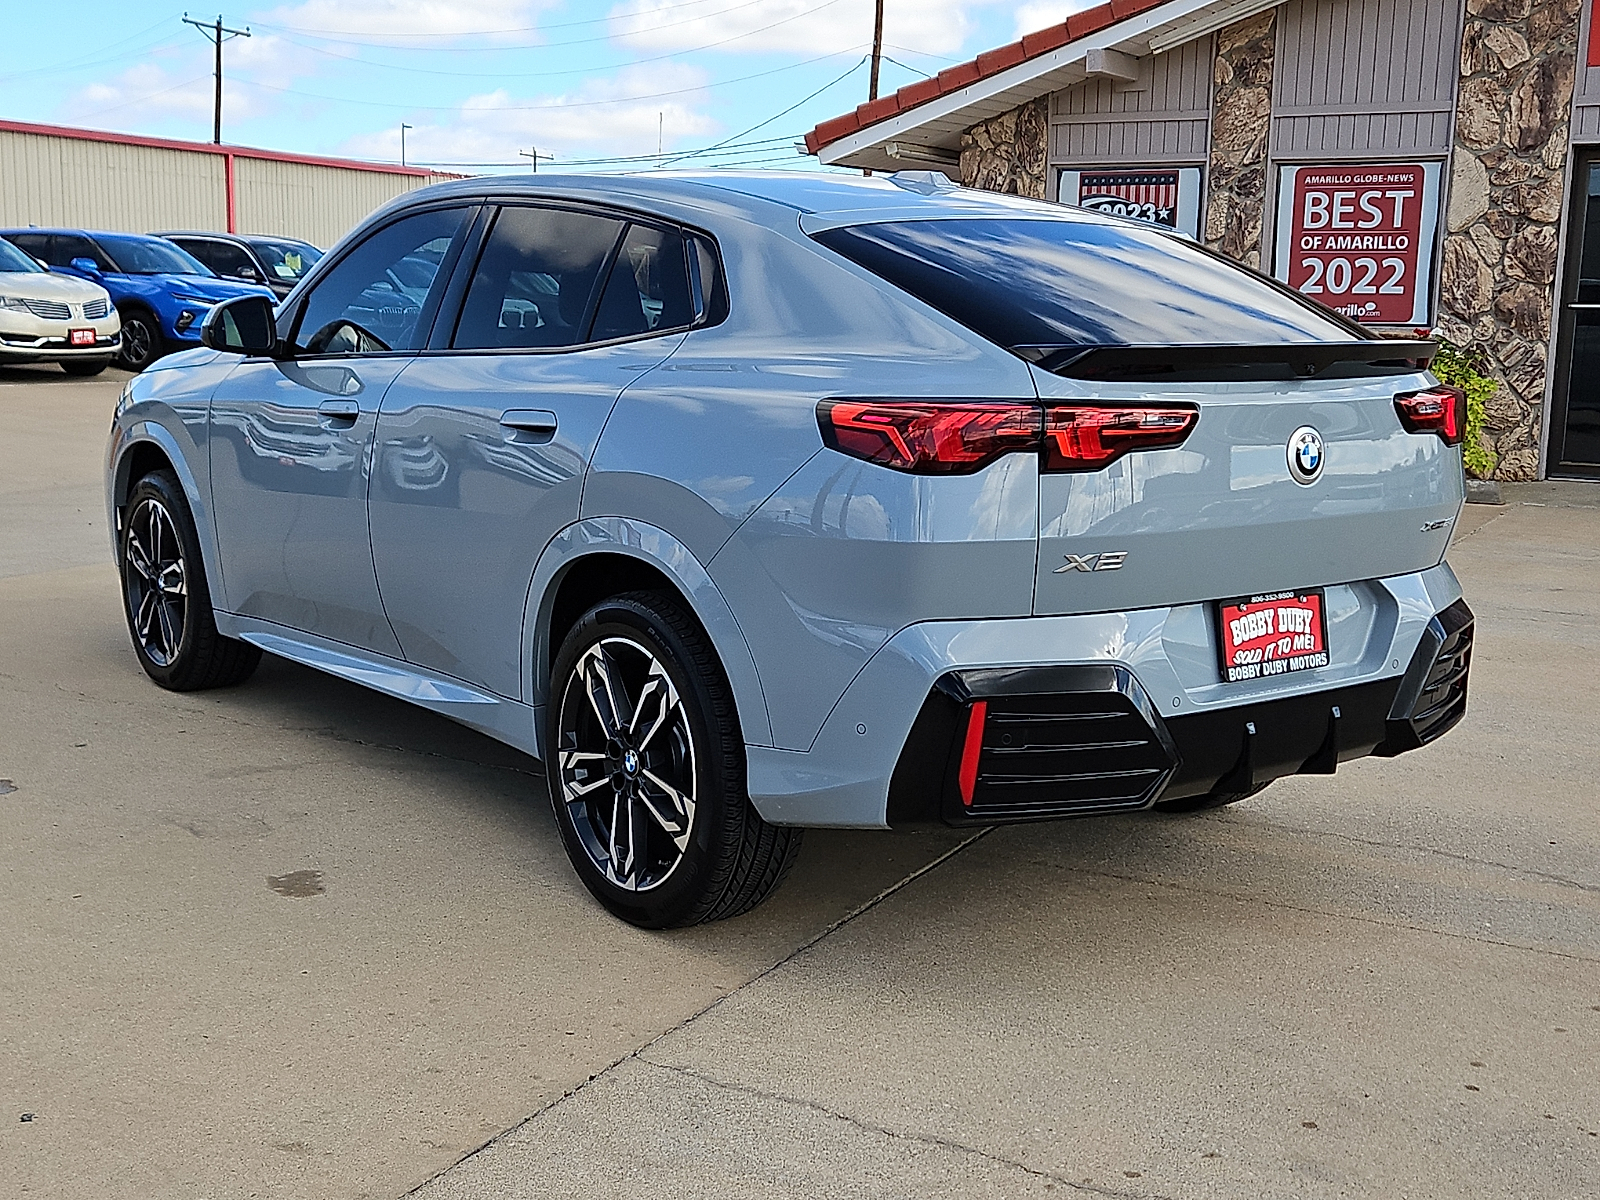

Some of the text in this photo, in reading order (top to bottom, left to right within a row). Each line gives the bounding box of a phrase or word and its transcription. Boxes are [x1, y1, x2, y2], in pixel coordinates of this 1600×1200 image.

[1304, 174, 1414, 184] AMARILLO GLOBE-NEWS
[1303, 190, 1415, 229] BEST
[1301, 236, 1409, 250] OF AMARILLO
[1299, 257, 1406, 294] 2022
[1230, 607, 1314, 646] BOBBY DUBY
[1233, 634, 1315, 665] SOLD IT TO ME!
[1228, 653, 1328, 681] BOBBY DUBY MOTORS
